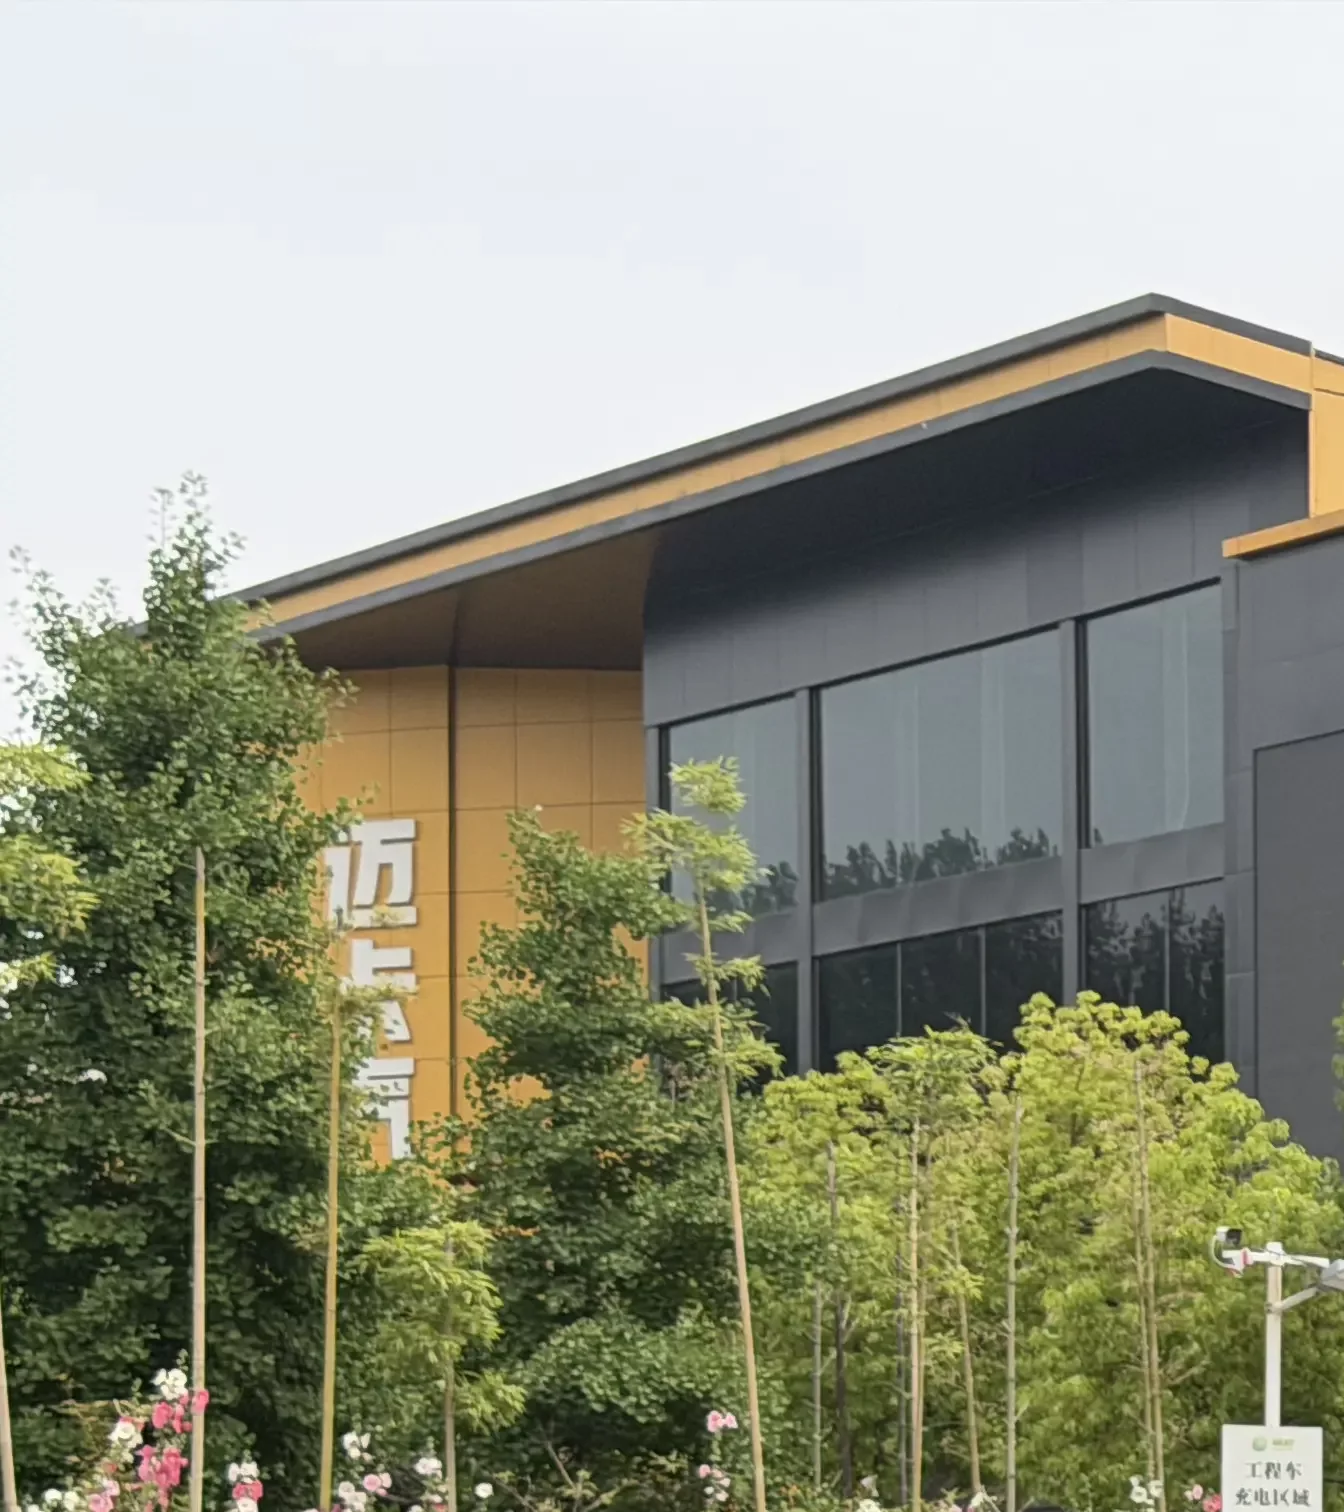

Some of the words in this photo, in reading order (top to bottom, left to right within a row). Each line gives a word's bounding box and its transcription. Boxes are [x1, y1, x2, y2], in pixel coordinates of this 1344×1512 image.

[1244, 1460, 1302, 1480] 工程车
[1235, 1487, 1311, 1507] 充电区域
